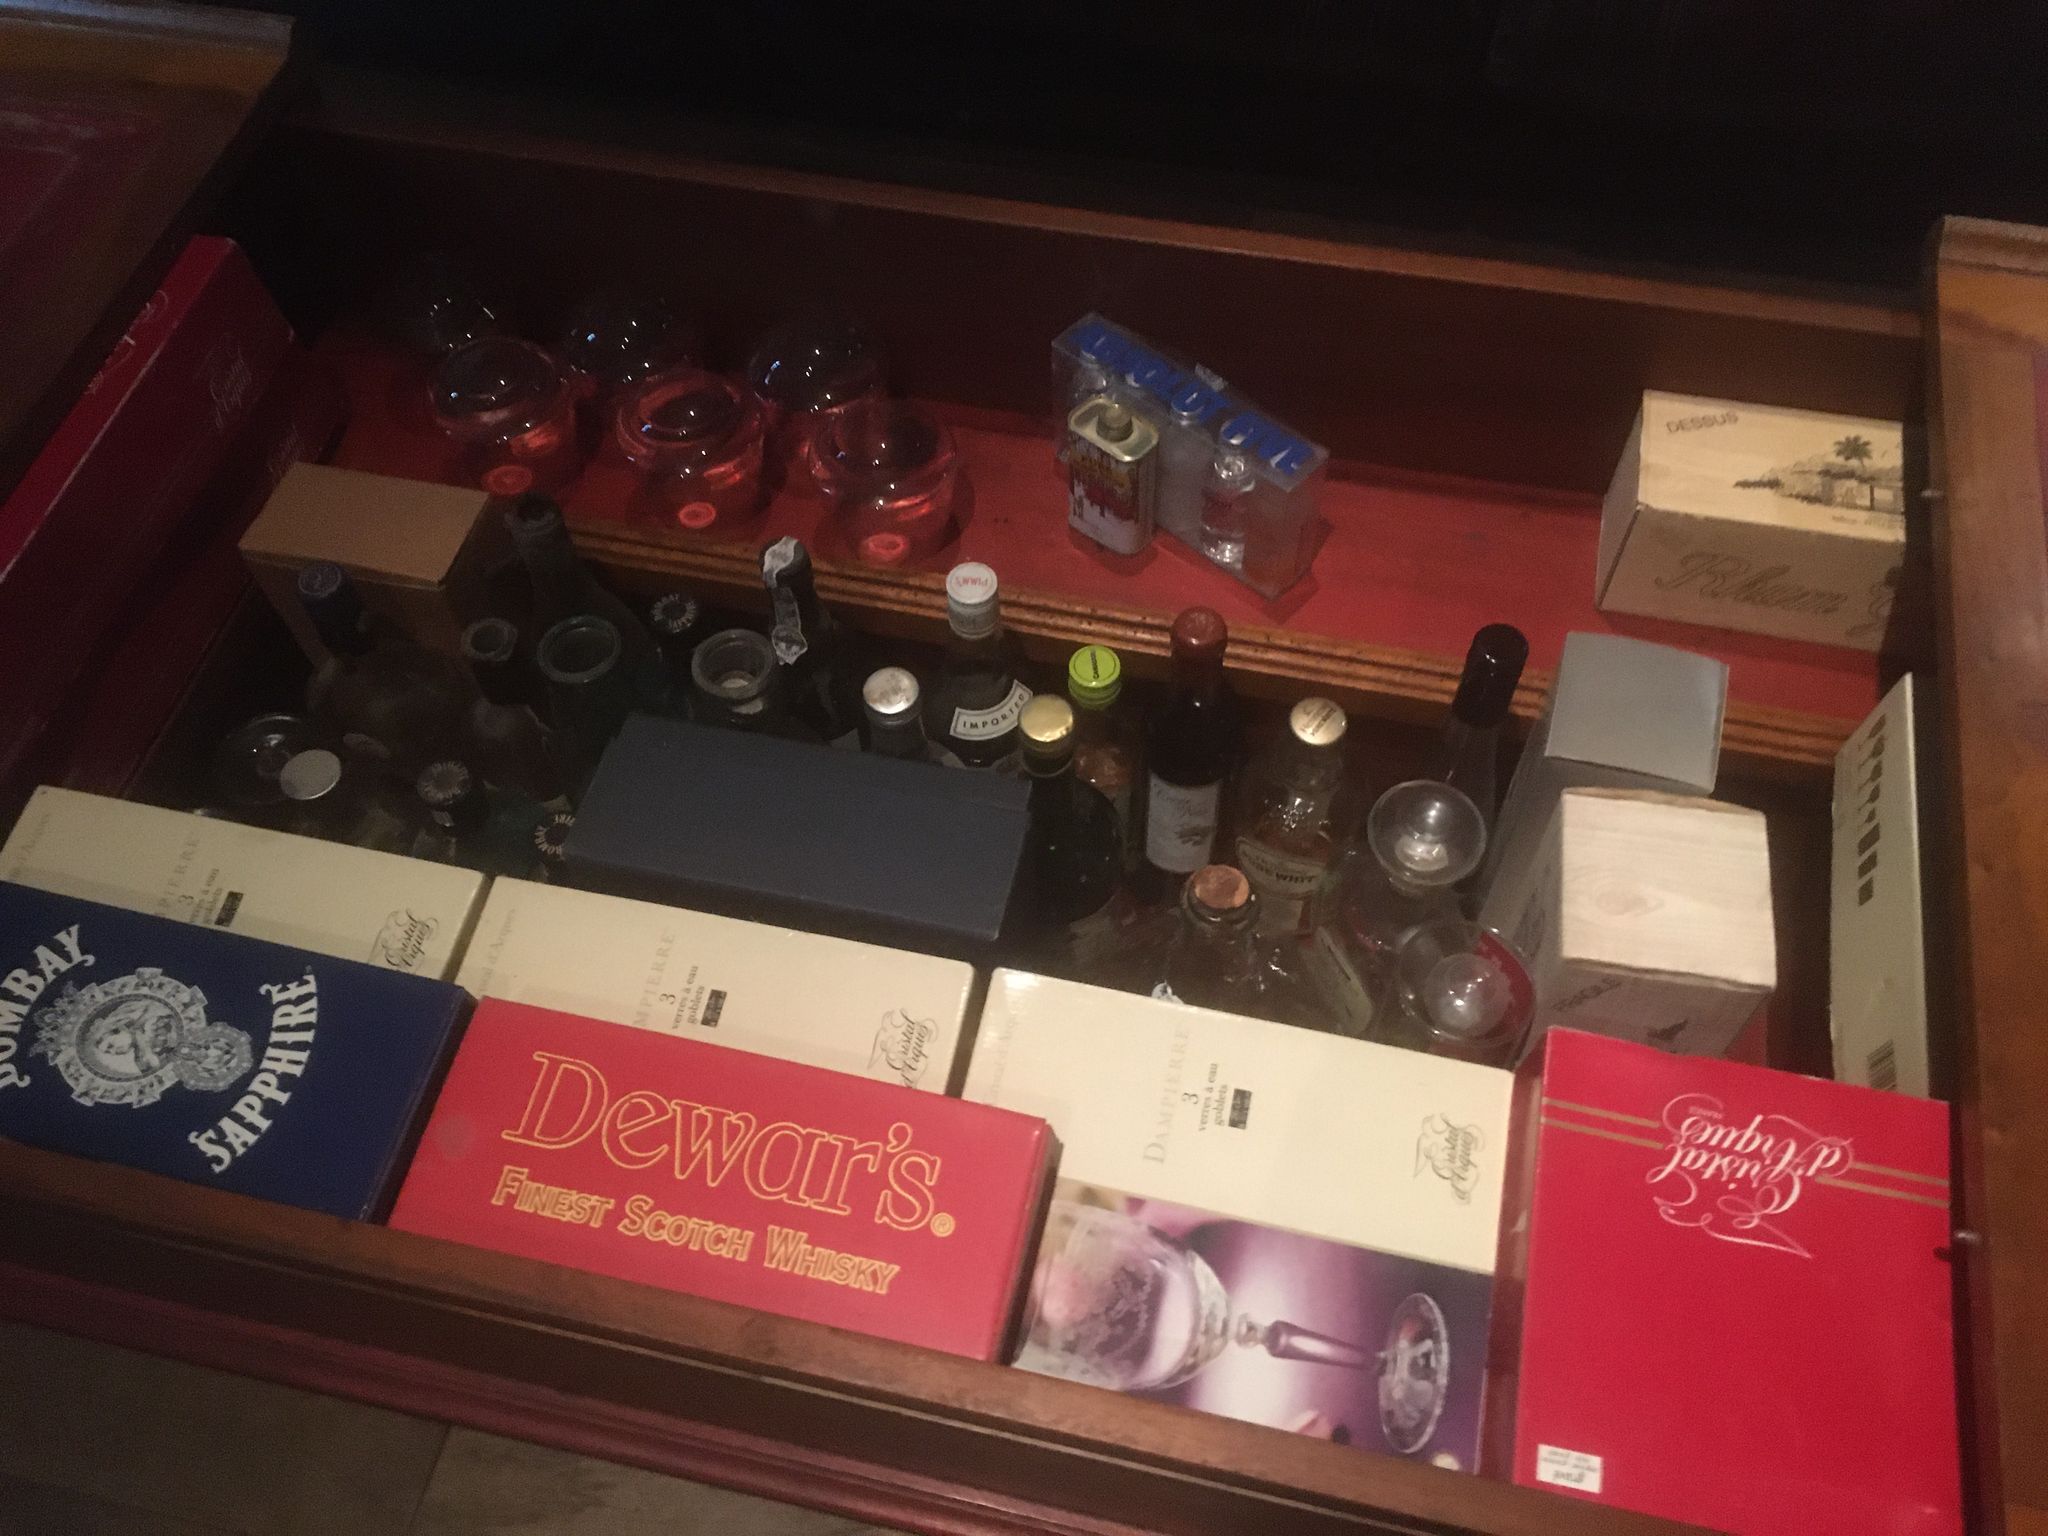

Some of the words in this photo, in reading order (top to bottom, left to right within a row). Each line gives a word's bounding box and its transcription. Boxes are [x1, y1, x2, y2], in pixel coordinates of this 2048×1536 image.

[1666, 411, 1739, 433] DESSUS
[962, 693, 1025, 730] IMPORTED
[634, 932, 677, 1028] MPIERRE
[658, 992, 677, 1005] 3
[672, 998, 688, 1030] verres
[687, 965, 699, 985] eau
[687, 985, 705, 1025] goblets
[189, 965, 318, 1174] SAPPHIRE
[1143, 1029, 1190, 1165] DAMPIERRE
[1181, 1091, 1199, 1105] 3
[1198, 1096, 1212, 1132] verres
[1207, 1063, 1219, 1083] eau
[1211, 1084, 1228, 1127] goblets
[491, 1164, 615, 1229] FINEST
[618, 1194, 755, 1263] SCOTCH
[763, 1224, 901, 1296] WHISKY
